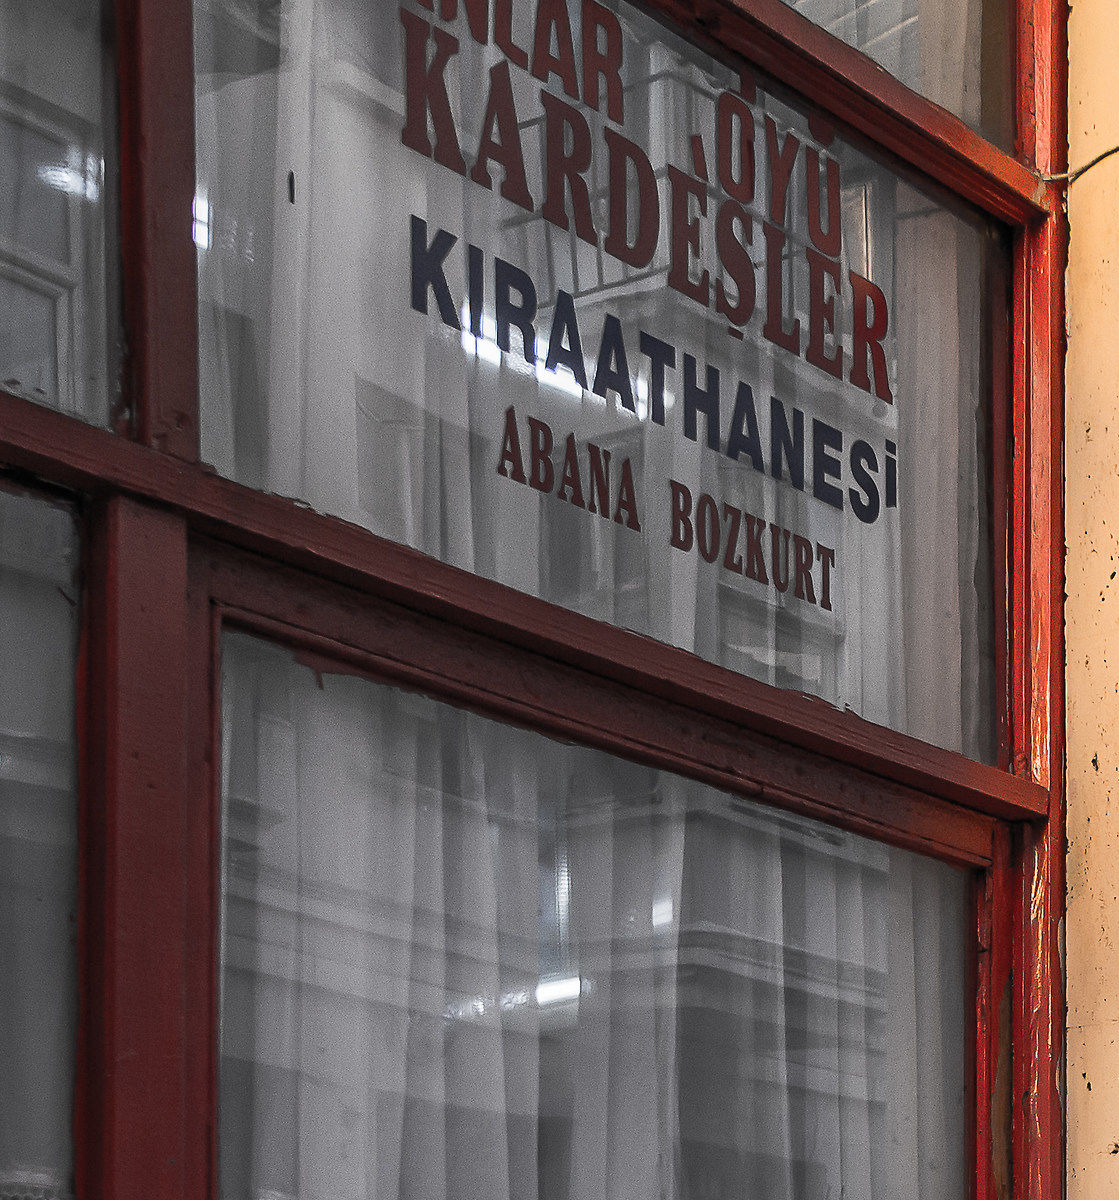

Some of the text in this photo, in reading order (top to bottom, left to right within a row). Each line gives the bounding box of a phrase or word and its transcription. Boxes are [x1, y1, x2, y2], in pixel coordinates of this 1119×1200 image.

[402, 10, 894, 405] KARDEŞLER
[690, 72, 843, 259] ÖYÜ
[497, 405, 837, 612] ABANA BOZKURT
